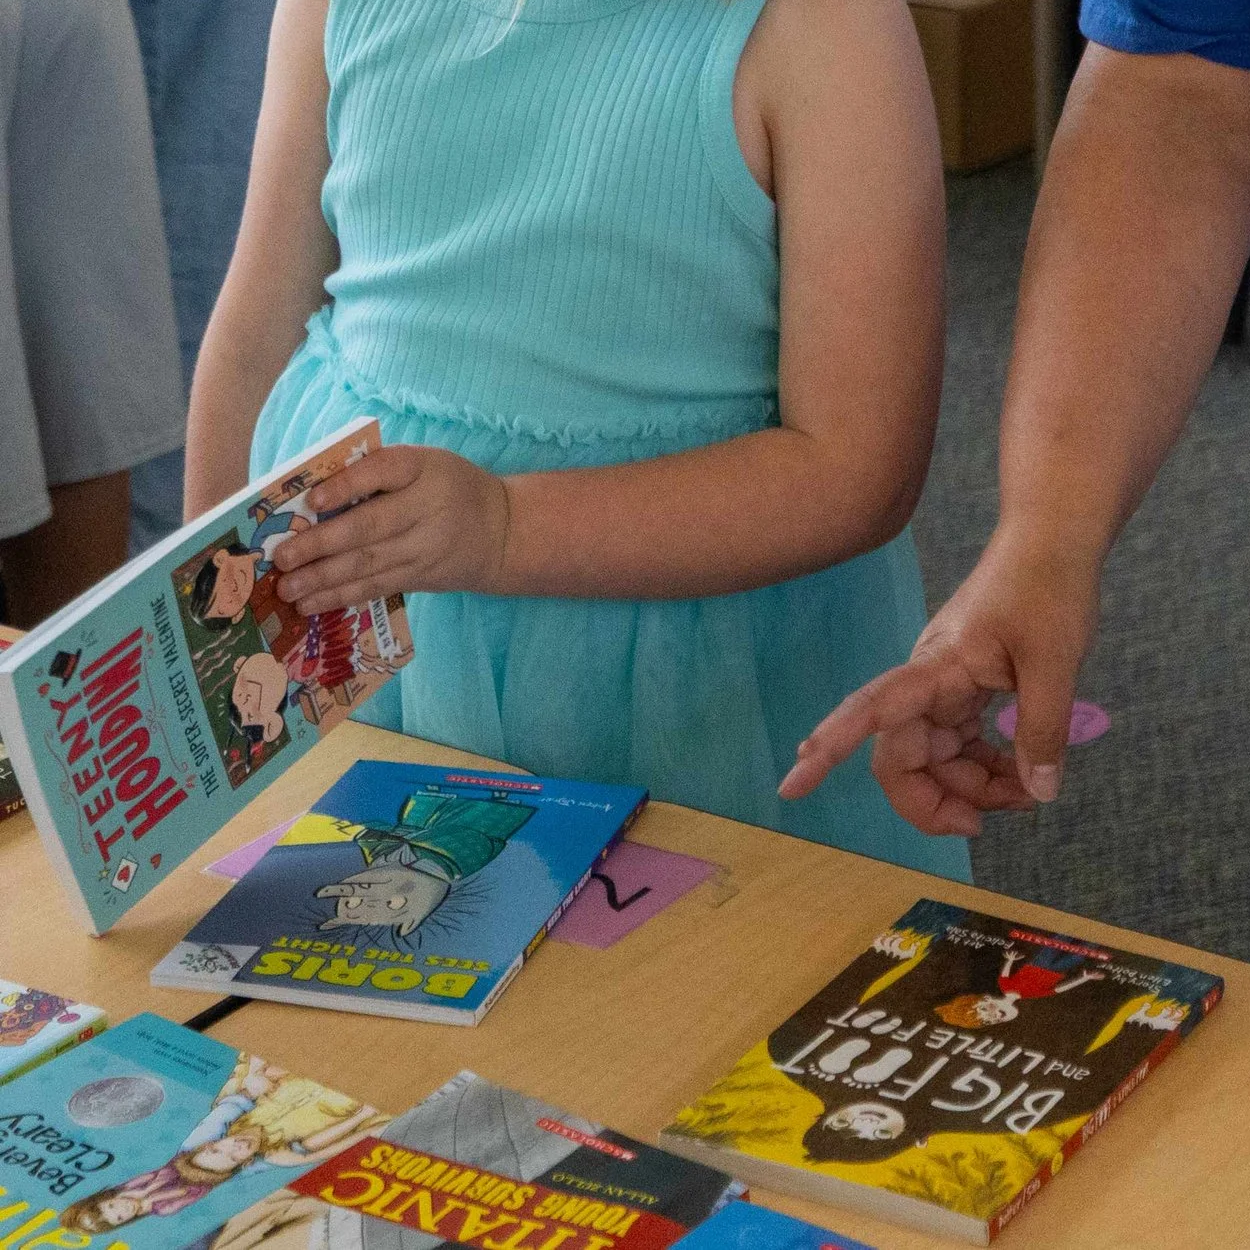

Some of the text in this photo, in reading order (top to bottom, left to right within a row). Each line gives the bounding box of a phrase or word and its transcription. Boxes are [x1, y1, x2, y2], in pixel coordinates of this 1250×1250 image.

[150, 592, 220, 798] THE SUPER-SECRET VALENTINE
[80, 626, 188, 841] HOUDINI
[50, 690, 125, 863] TEENY
[447, 775, 530, 791] SCHOLASTIC
[272, 935, 490, 971] SEES THE LIGHT
[1010, 929, 1092, 956] SCHOLASTIC
[252, 951, 478, 998] BORIS
[827, 1007, 1090, 1081] and LITTLE FOOT
[774, 1029, 1064, 1135] BIG FOOT
[539, 1118, 624, 1157] SCHOLASTIC
[361, 1144, 640, 1238] YOUNG SURVIVORS
[612, 1185, 659, 1205] ALLAN
